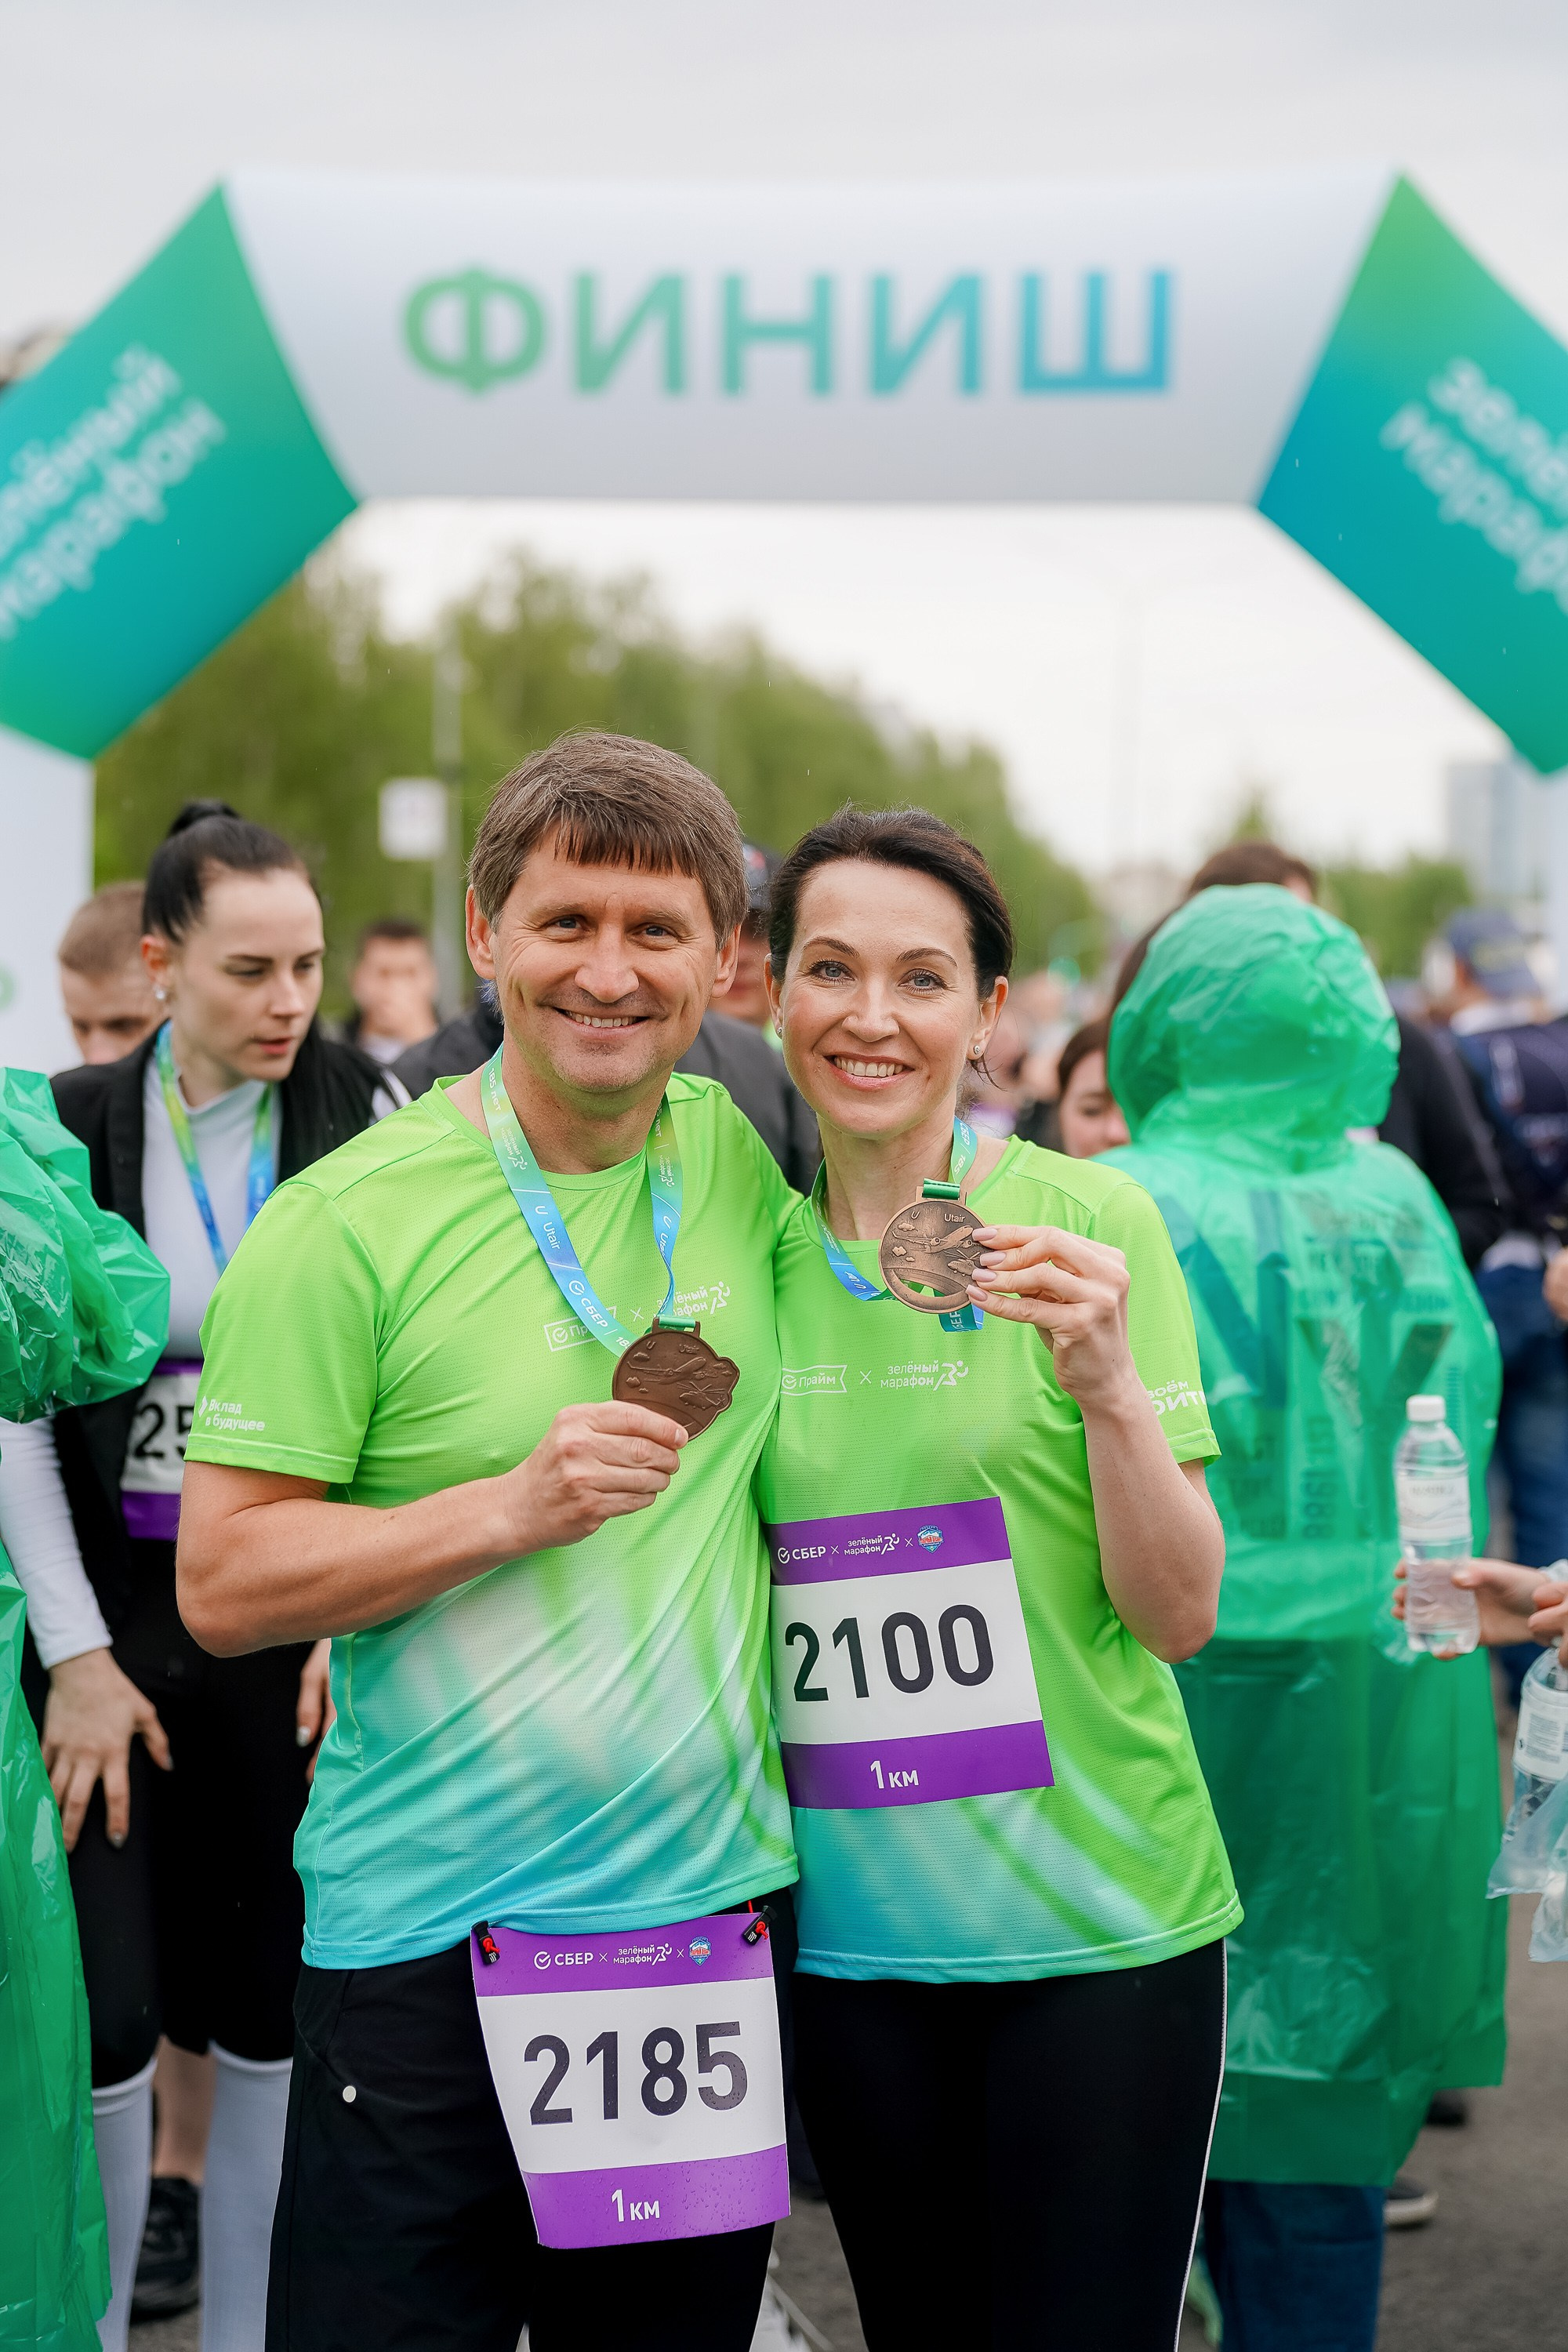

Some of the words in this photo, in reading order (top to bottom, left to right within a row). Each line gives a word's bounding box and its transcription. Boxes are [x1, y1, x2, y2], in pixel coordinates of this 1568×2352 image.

[401, 266, 1171, 397] ФИНИШ
[0, 340, 182, 561] лёный
[488, 1068, 497, 1089] 185
[491, 1091, 502, 1112] лет
[506, 1127, 522, 1156] зелёный
[959, 1122, 971, 1146] СБЕР
[953, 1154, 966, 1175] 185
[944, 1213, 966, 1223] Utair
[543, 1221, 561, 1250] Utair
[581, 1297, 608, 1328] СБЕР
[887, 1360, 939, 1375] зелёный
[799, 1373, 836, 1388] Прайм
[880, 1376, 934, 1389] марафон
[209, 1399, 242, 1415] Вклад
[205, 1417, 211, 1426] в
[212, 1413, 265, 1432] будущее
[848, 1535, 883, 1547] зелёный
[792, 1546, 826, 1560] СБЕР
[844, 1546, 880, 1556] марафон
[785, 1604, 993, 1702] 2100
[554, 1952, 593, 1965] СБЕР
[618, 1944, 655, 1955] зелёный
[613, 1955, 652, 1965] марафон
[524, 2020, 748, 2126] 2185
